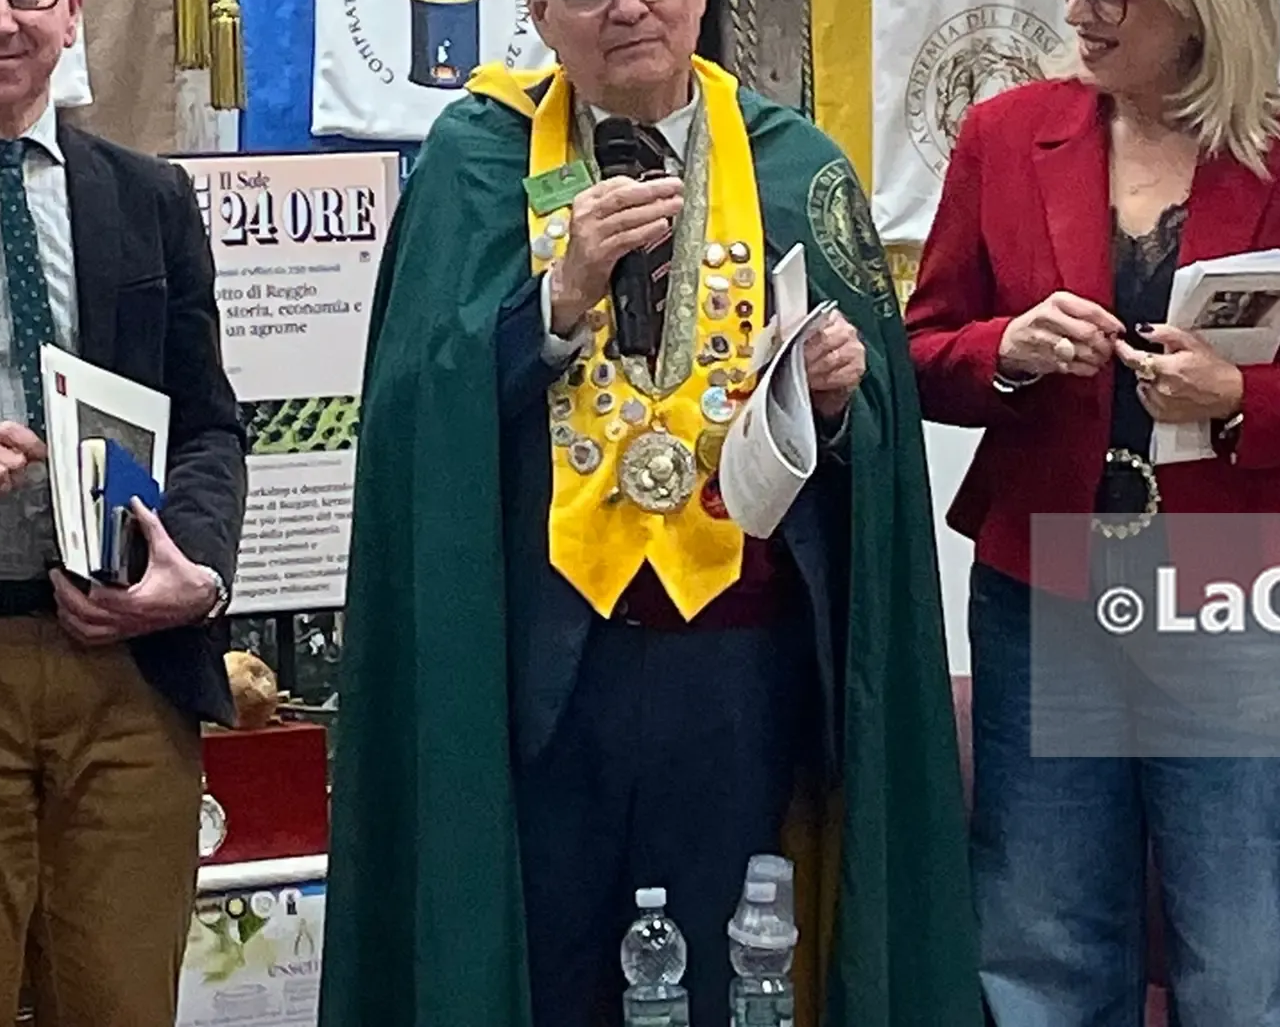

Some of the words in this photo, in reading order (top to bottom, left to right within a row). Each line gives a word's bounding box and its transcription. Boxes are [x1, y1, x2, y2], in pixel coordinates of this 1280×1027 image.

[236, 169, 270, 191] Sole
[220, 188, 279, 247] 24
[282, 185, 377, 244] ORE
[247, 284, 262, 299] di
[266, 282, 318, 302] Reggio
[278, 298, 350, 316] economia
[249, 322, 308, 339] agrume
